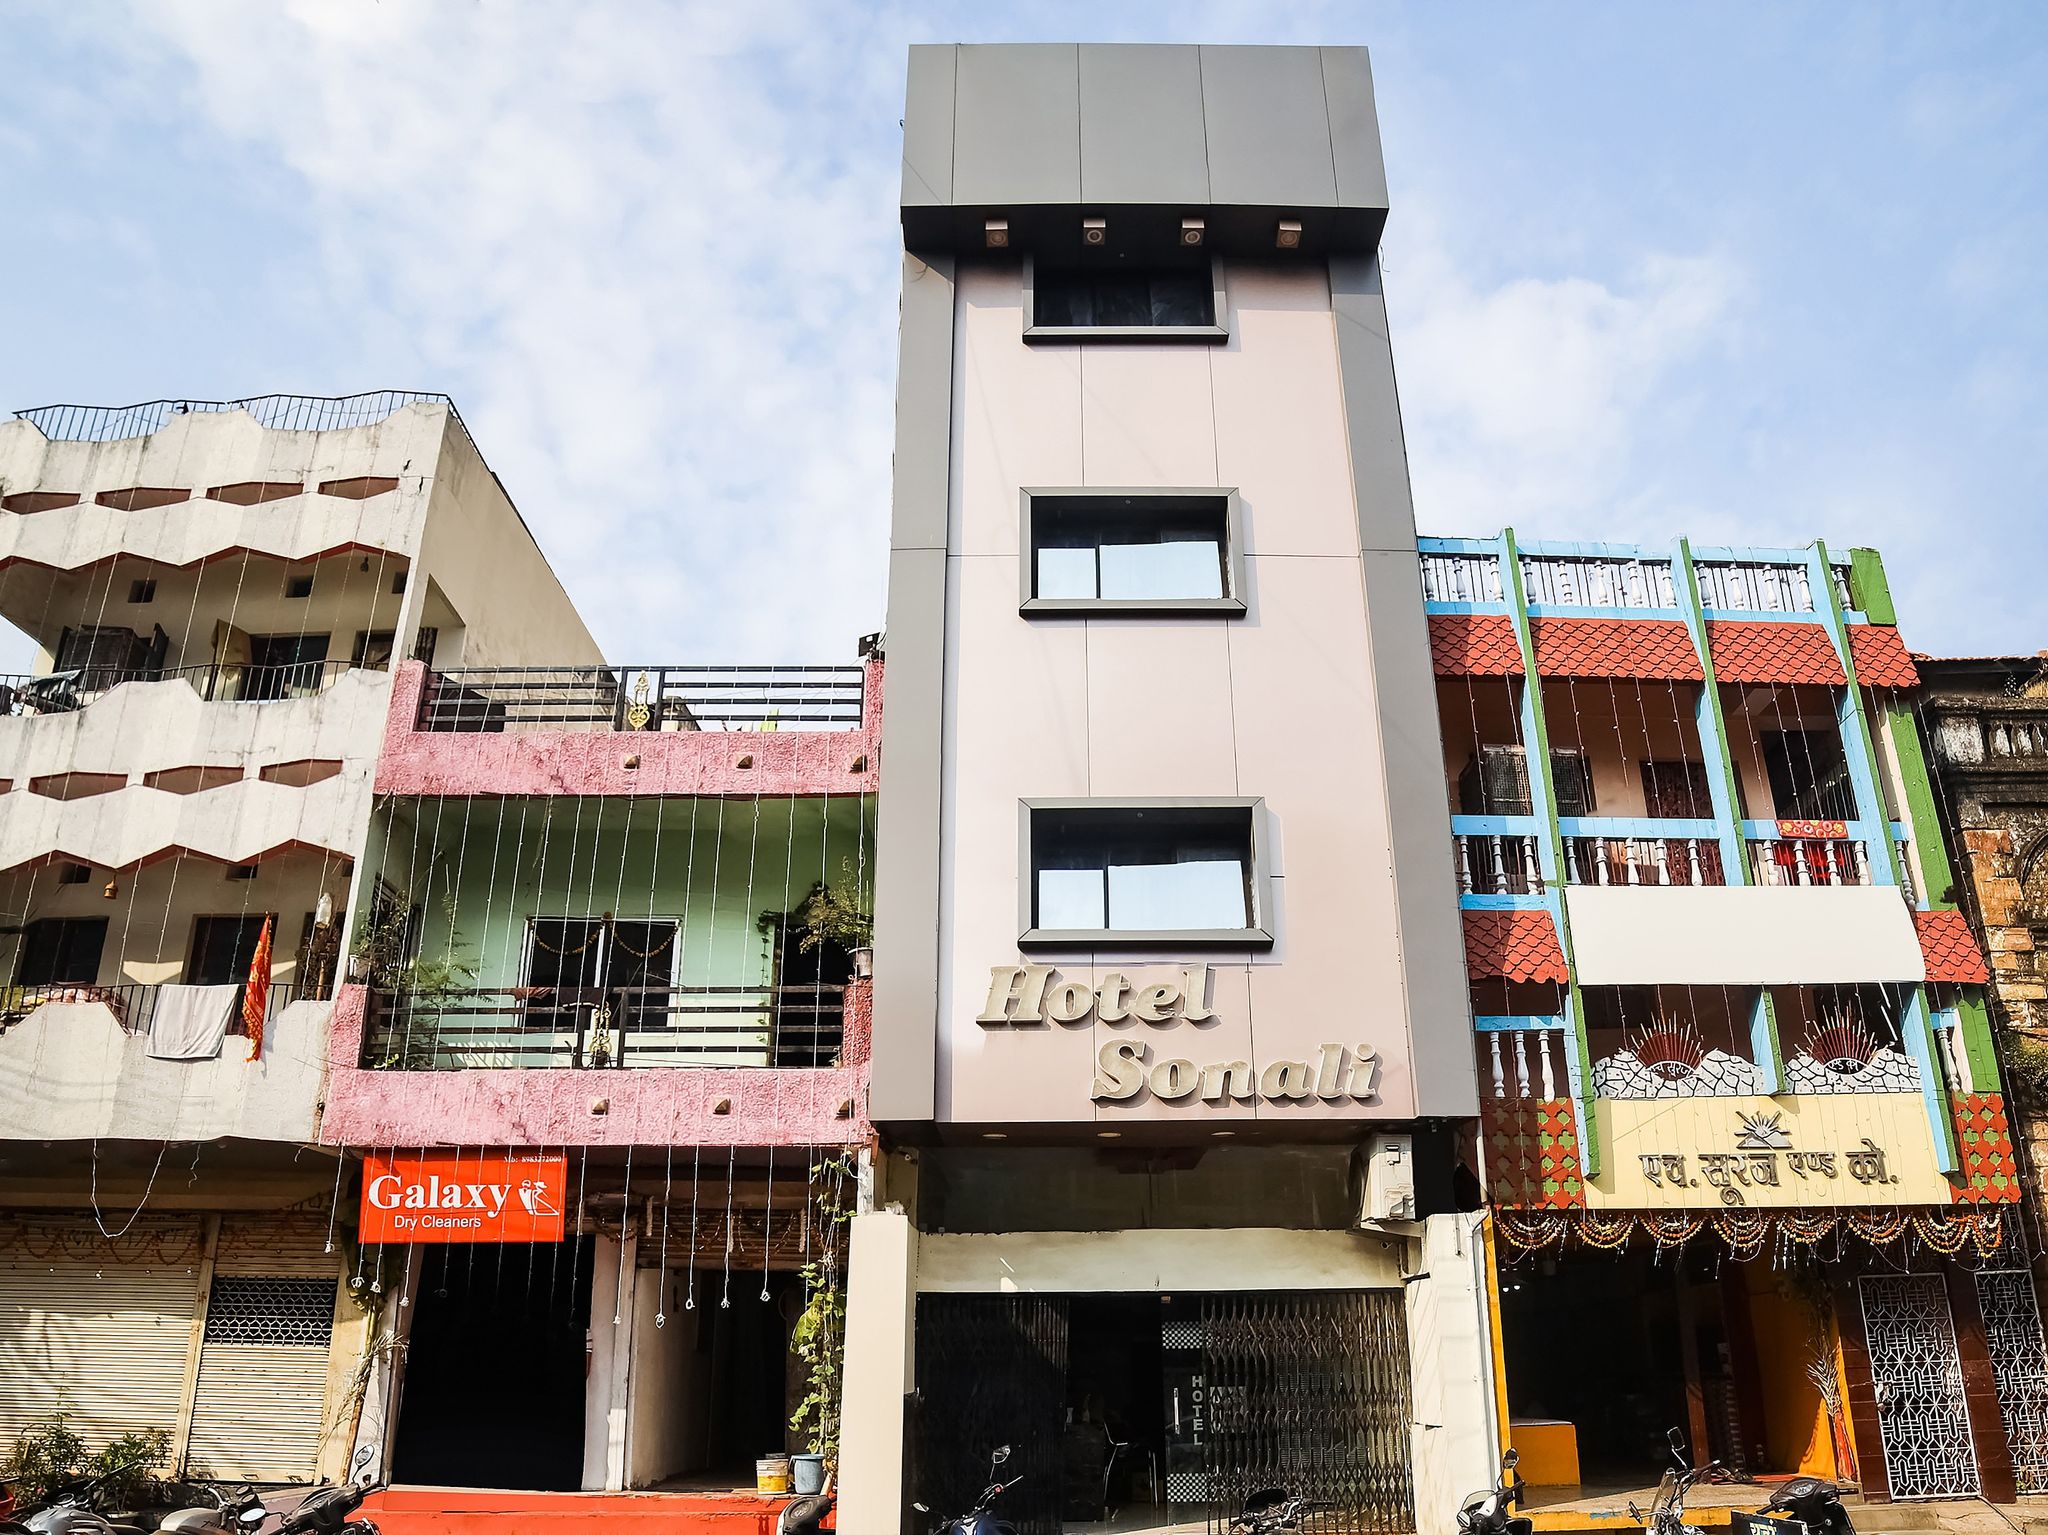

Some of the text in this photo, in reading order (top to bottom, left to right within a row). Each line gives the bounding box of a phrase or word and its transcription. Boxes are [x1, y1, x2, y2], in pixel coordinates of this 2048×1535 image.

[976, 962, 1217, 1023] Hotel
[1090, 1038, 1377, 1101] Sonali
[368, 1174, 512, 1218] Galaxy
[1638, 1138, 1899, 1205] एच. सूरज एण्ड को.
[394, 1214, 481, 1231] Dry Cleaners
[1191, 1375, 1204, 1446] HOTEL
